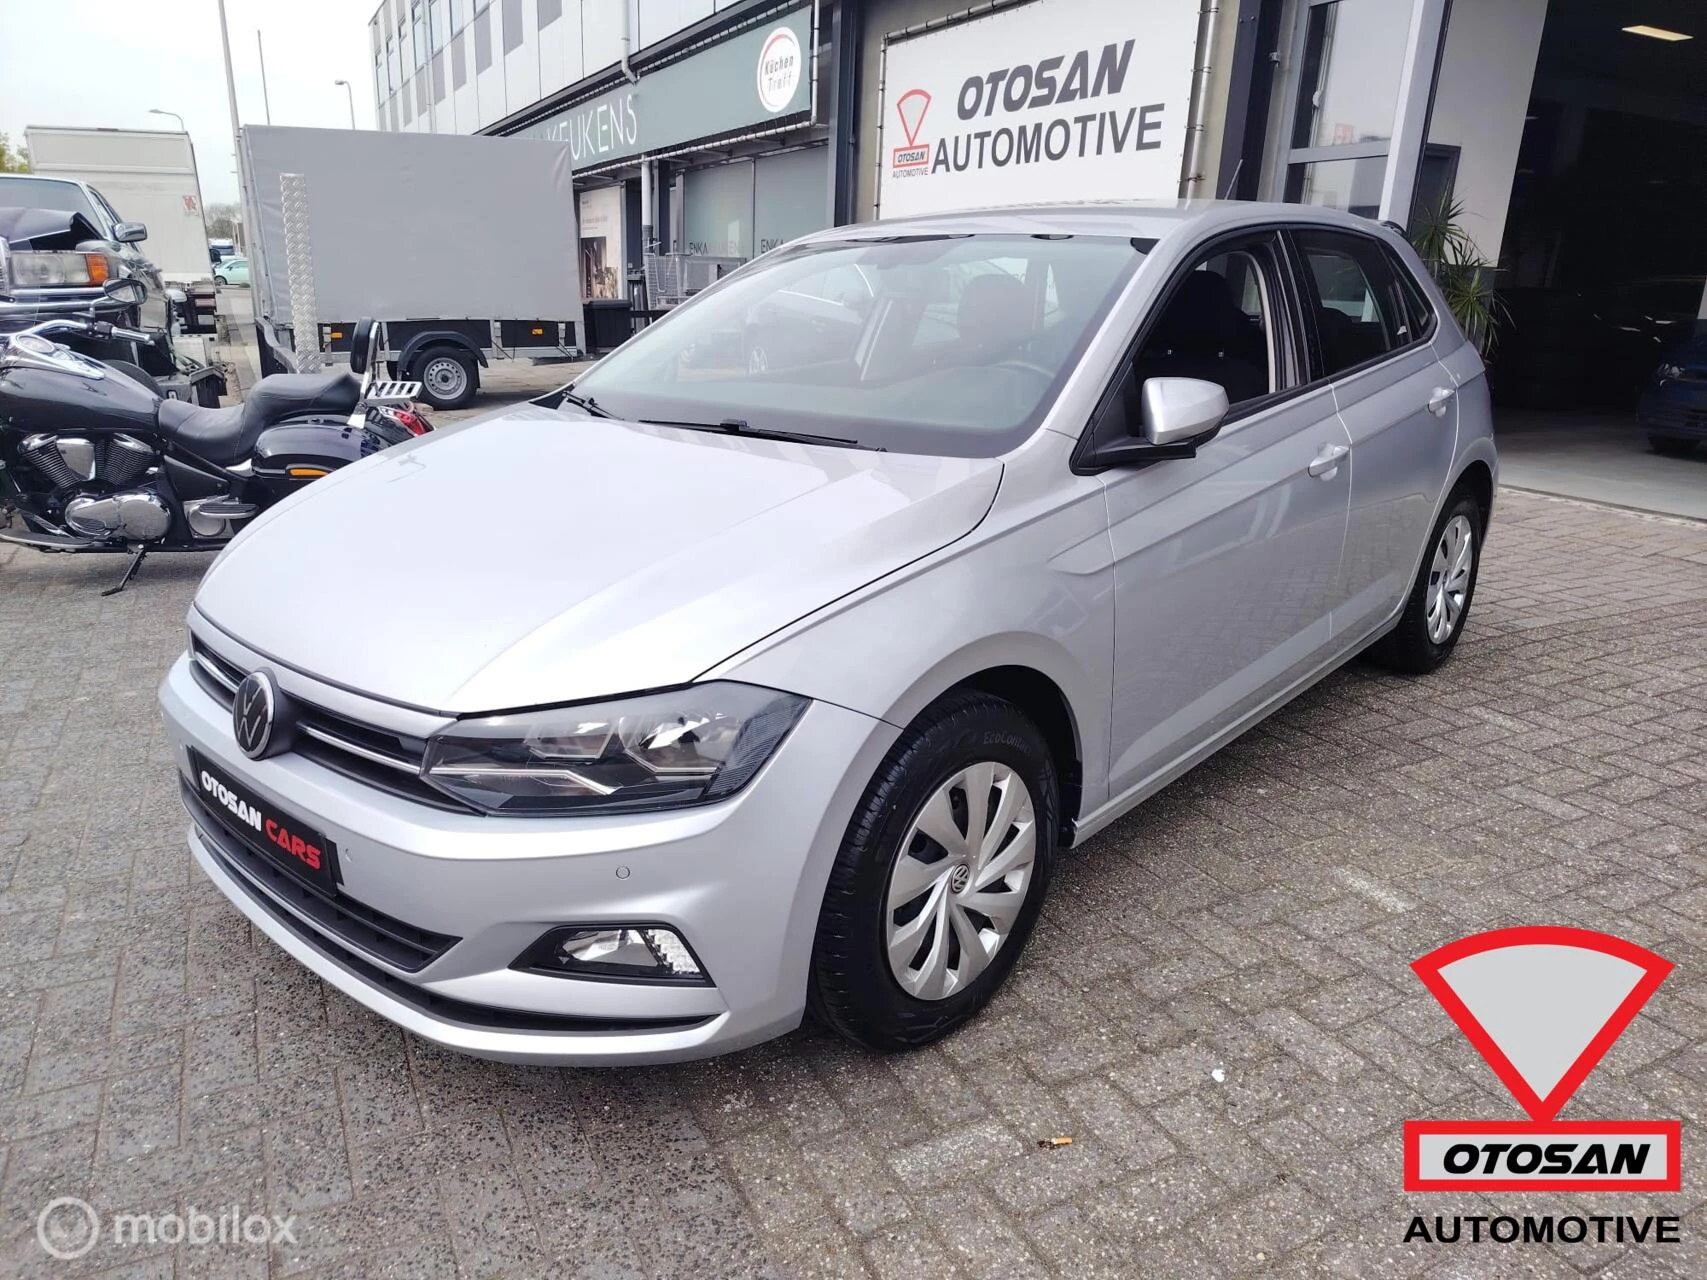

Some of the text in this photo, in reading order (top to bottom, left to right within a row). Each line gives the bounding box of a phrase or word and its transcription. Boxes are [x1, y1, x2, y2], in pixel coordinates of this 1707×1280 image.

[957, 39, 1136, 121] OTOSAN
[897, 150, 926, 163] OTOSAN
[931, 103, 1165, 174] AUTOMOTIVE
[892, 167, 929, 178] AUTOMOTIVE
[760, 239, 784, 254] ENK
[201, 770, 321, 870] OTOSAN CARS
